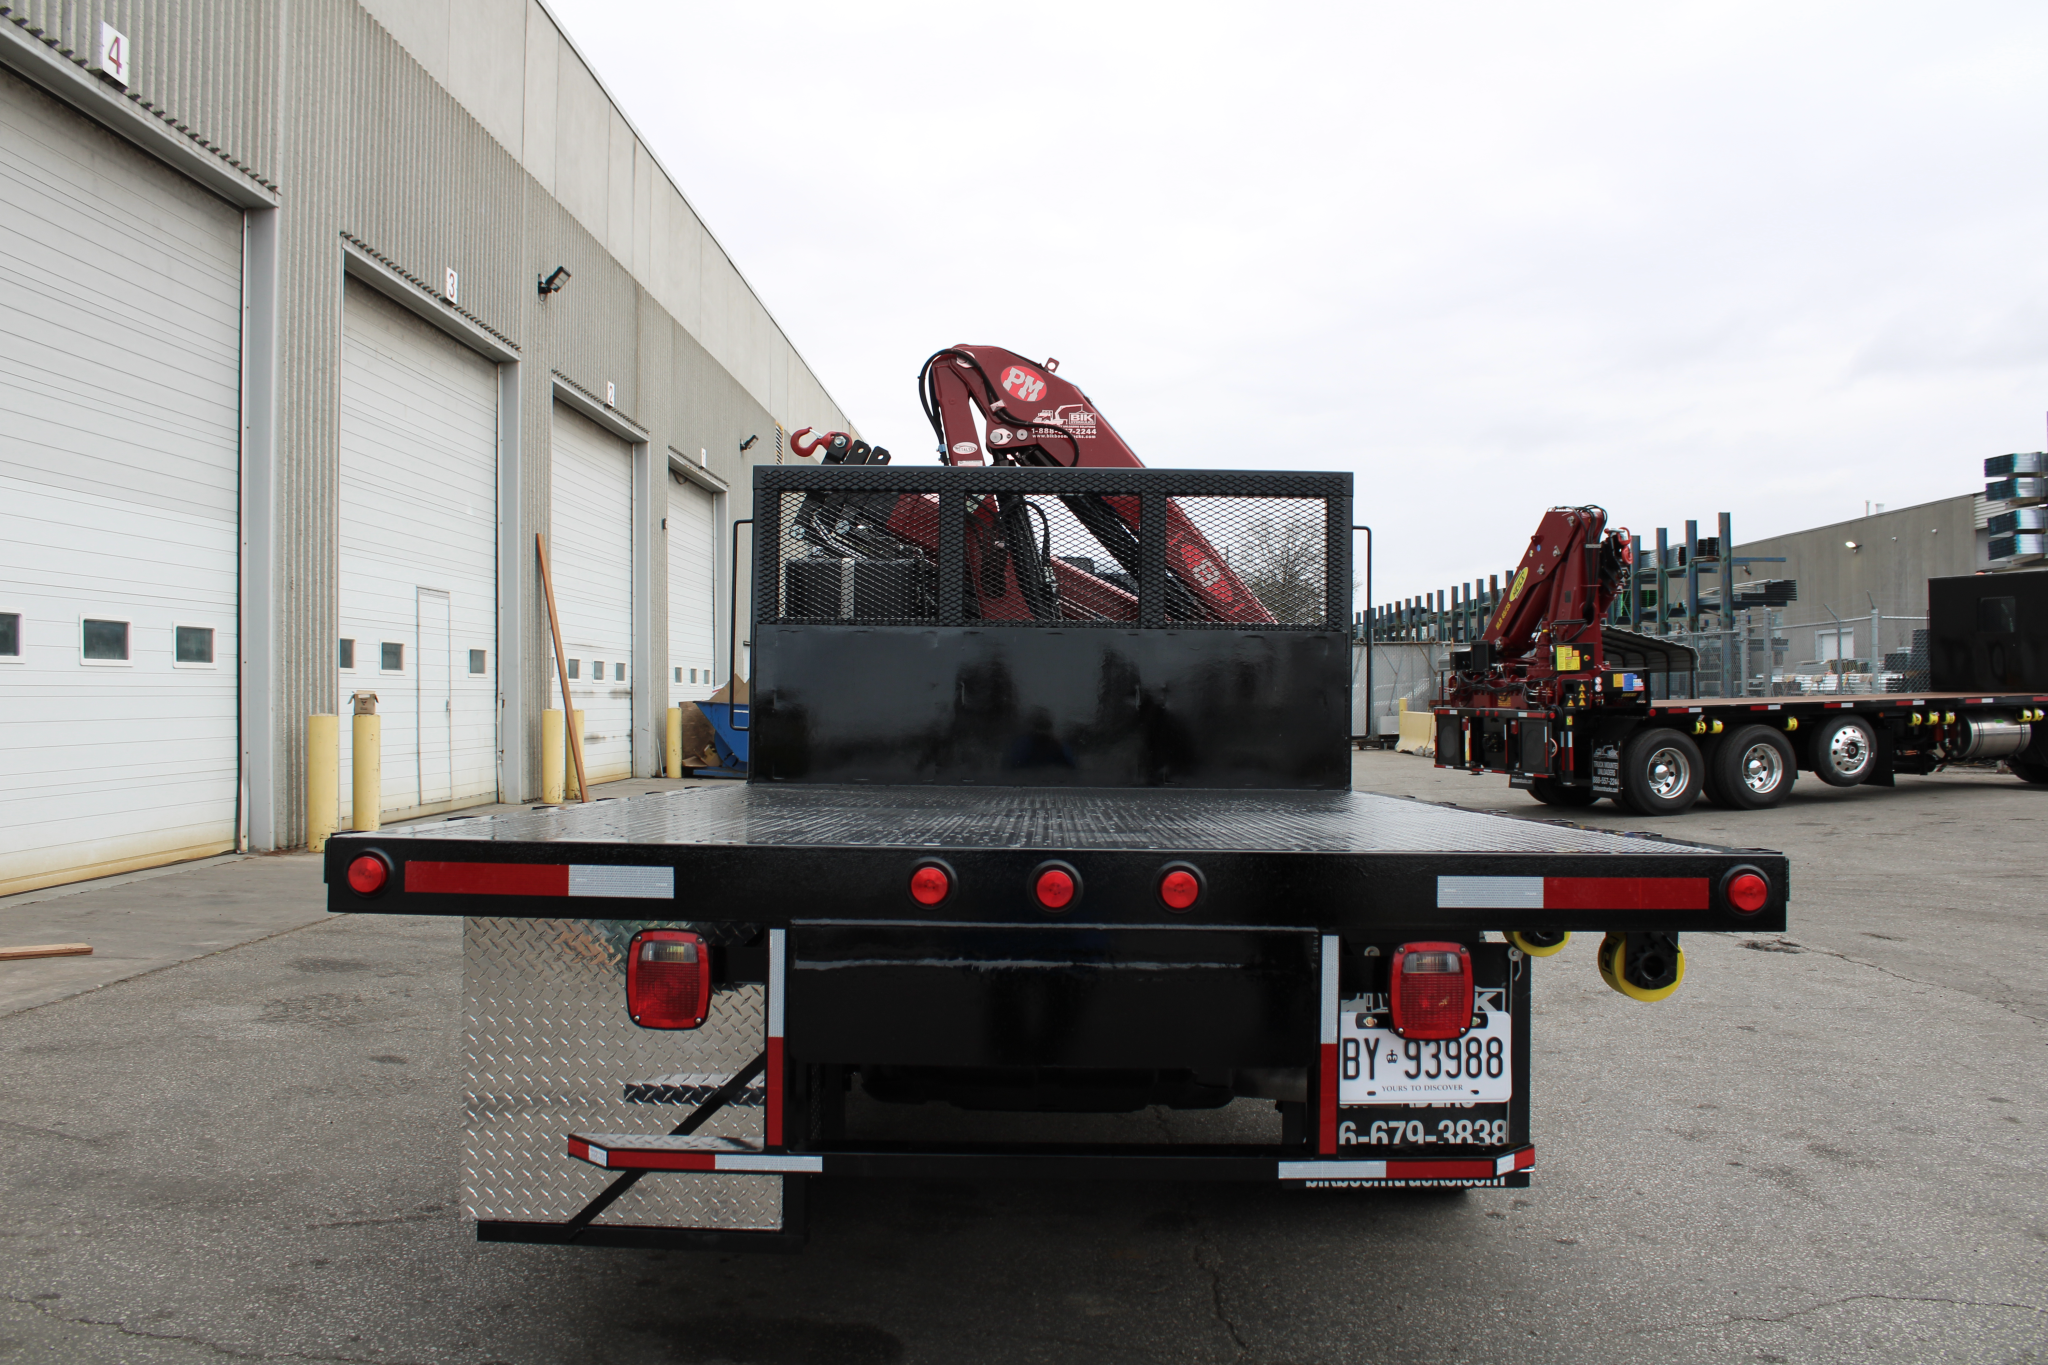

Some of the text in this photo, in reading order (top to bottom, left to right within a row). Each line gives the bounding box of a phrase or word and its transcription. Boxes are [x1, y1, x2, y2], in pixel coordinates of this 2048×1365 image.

[108, 36, 122, 75] 4
[449, 272, 455, 299] 3
[1003, 367, 1045, 401] PM
[1070, 414, 1094, 422] BIK
[1342, 1036, 1503, 1080] BY 93988
[1424, 1084, 1464, 1092] DISCOVER
